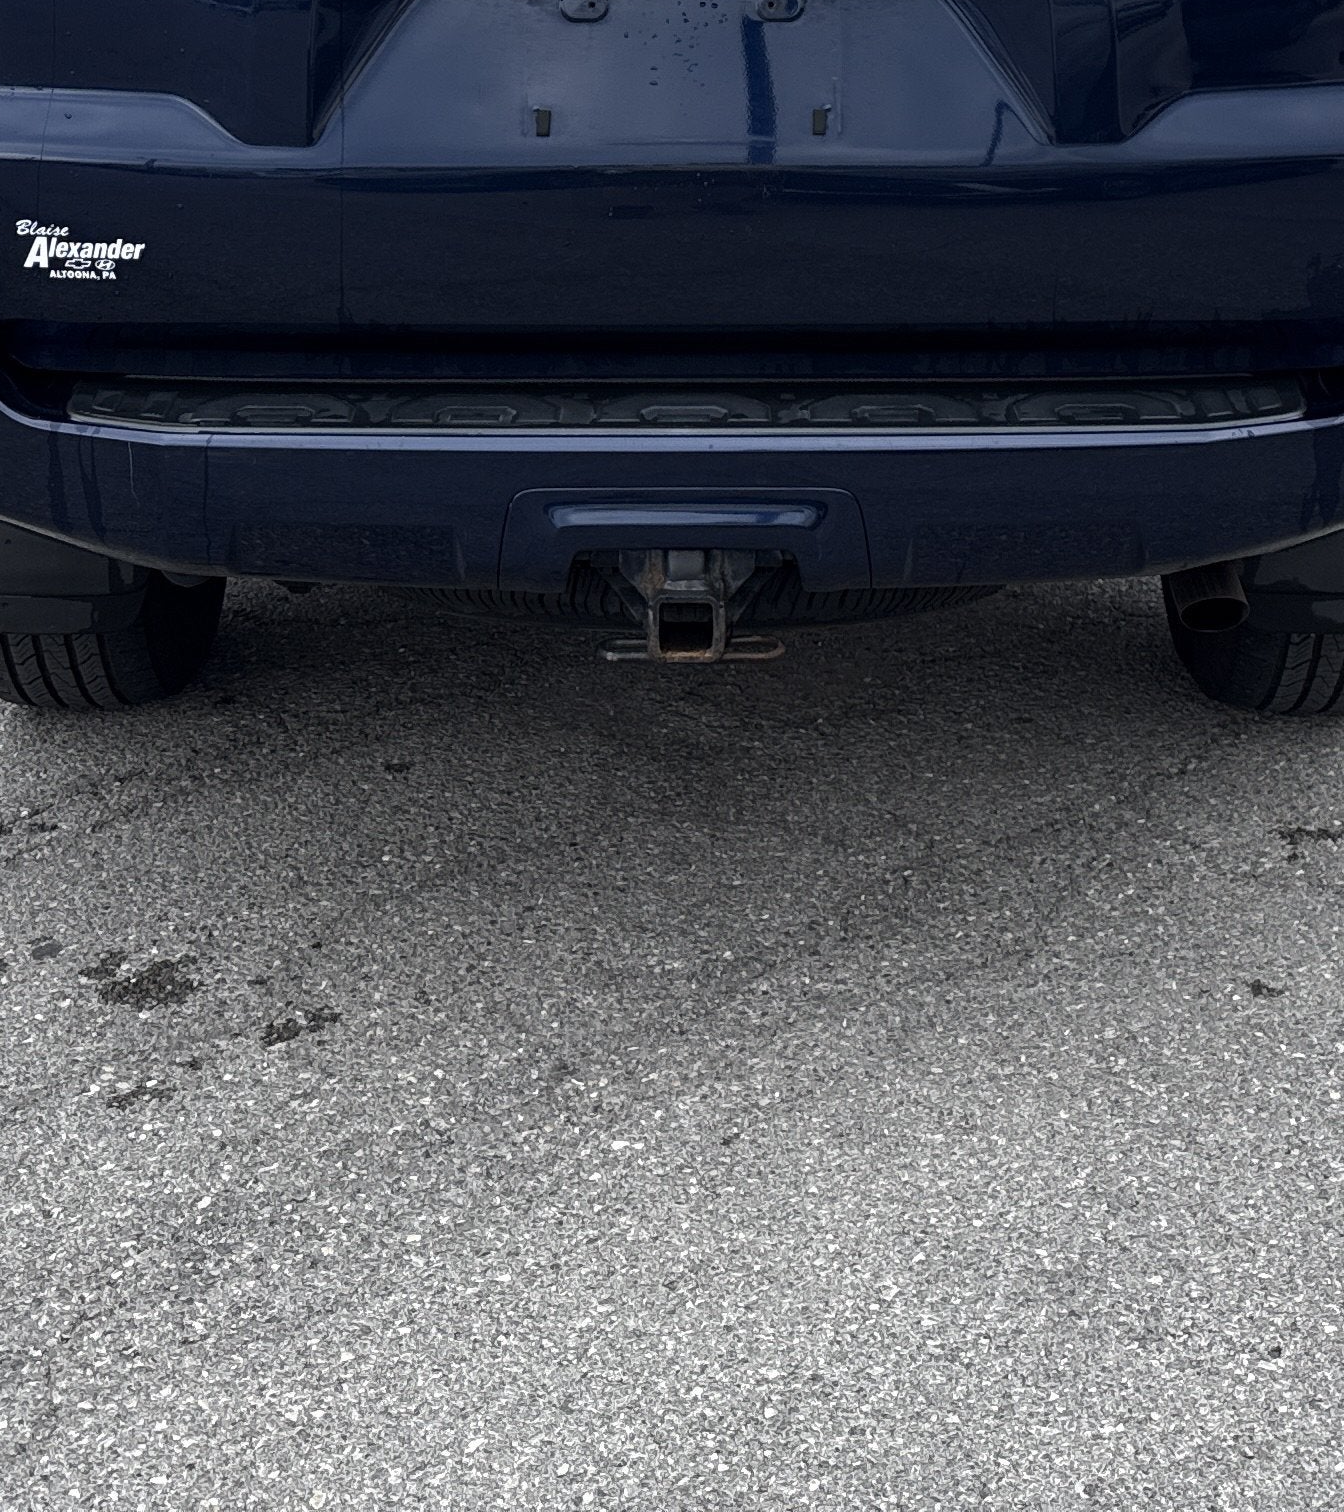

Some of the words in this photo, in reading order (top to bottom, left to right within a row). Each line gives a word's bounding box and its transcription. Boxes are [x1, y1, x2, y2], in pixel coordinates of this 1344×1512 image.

[15, 219, 69, 236] Blaise
[23, 236, 146, 268] Alexander
[49, 270, 101, 281] ALTOONA,
[102, 270, 117, 280] PA
